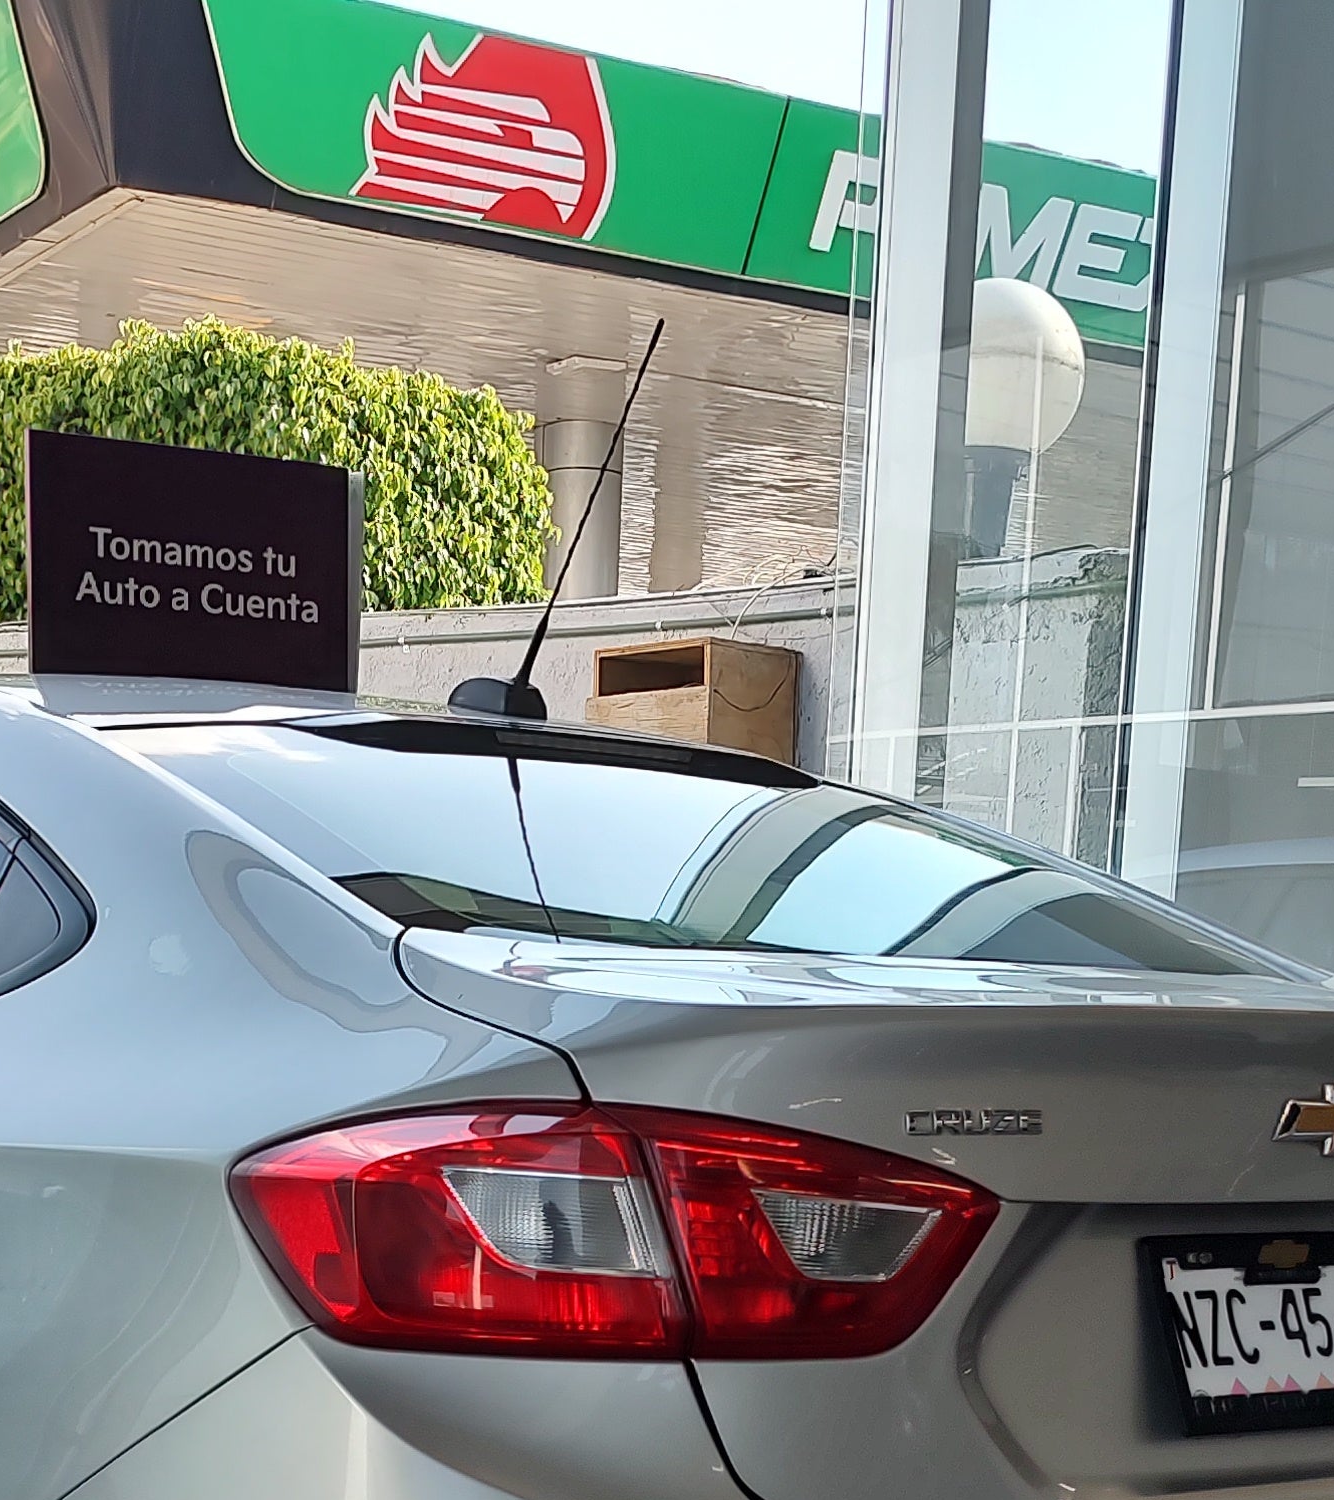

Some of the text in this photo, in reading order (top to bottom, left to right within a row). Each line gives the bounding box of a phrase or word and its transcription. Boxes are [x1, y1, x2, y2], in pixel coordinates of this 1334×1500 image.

[809, 150, 1156, 312] PME
[88, 525, 297, 578] Tomamos tu
[75, 570, 319, 624] Auto a Cuenta
